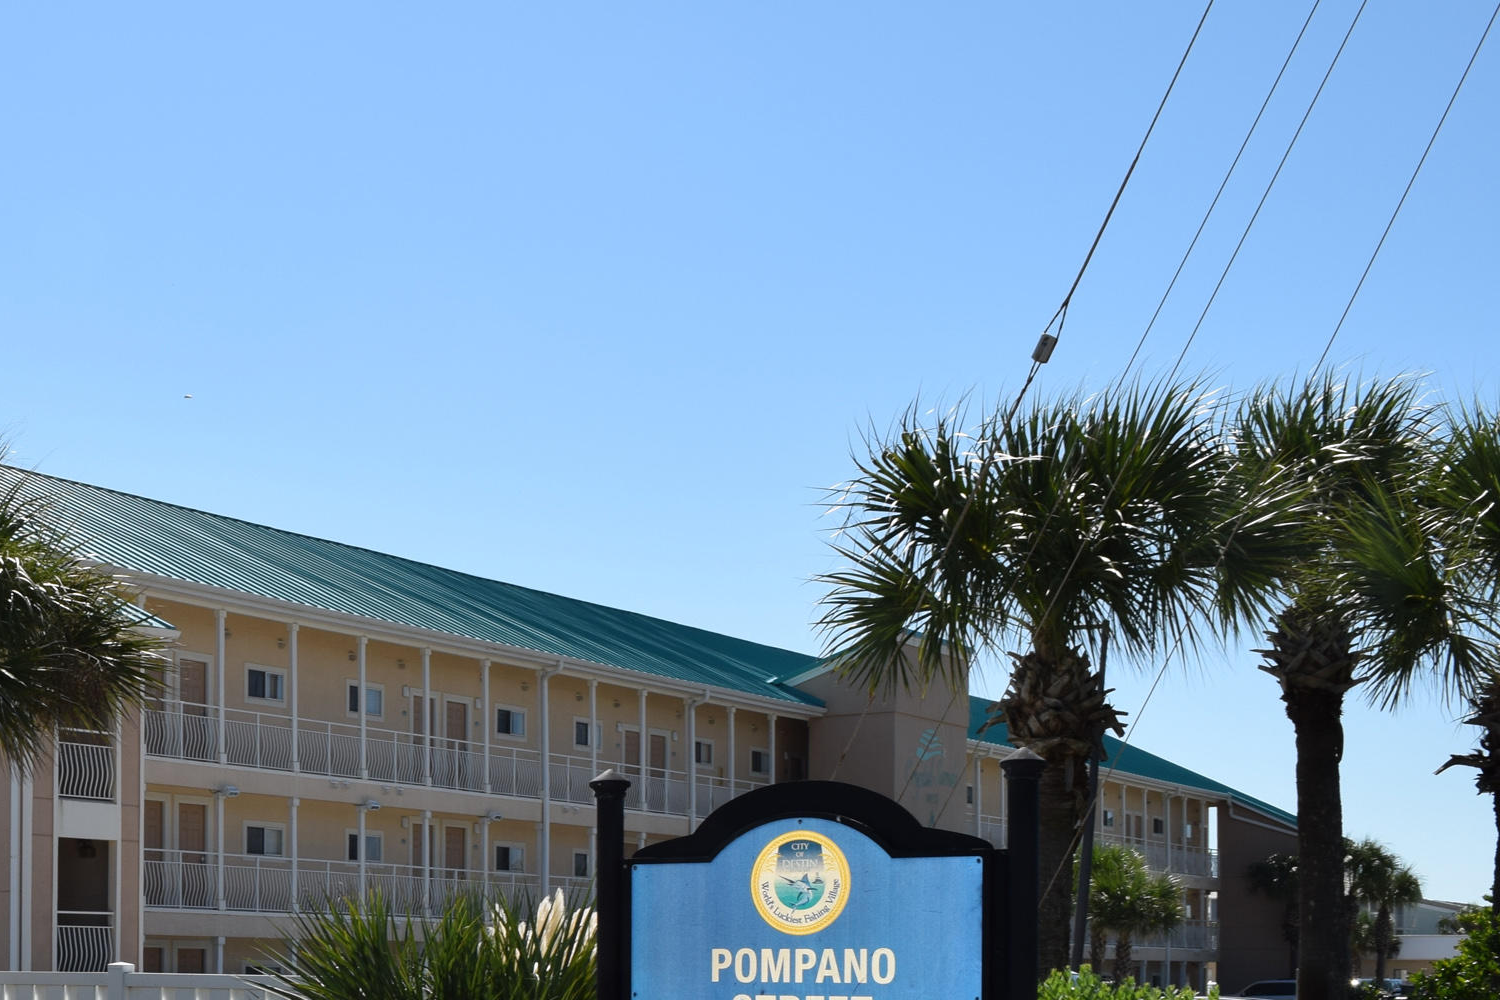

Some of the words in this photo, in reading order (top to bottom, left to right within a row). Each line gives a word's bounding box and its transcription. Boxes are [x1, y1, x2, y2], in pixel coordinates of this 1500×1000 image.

[782, 859, 818, 868] DESTIN
[761, 881, 774, 910] World's
[773, 907, 802, 924] Luckiest
[804, 905, 830, 923] Fishing
[826, 879, 840, 903] Village
[711, 948, 896, 985] POMPANO
